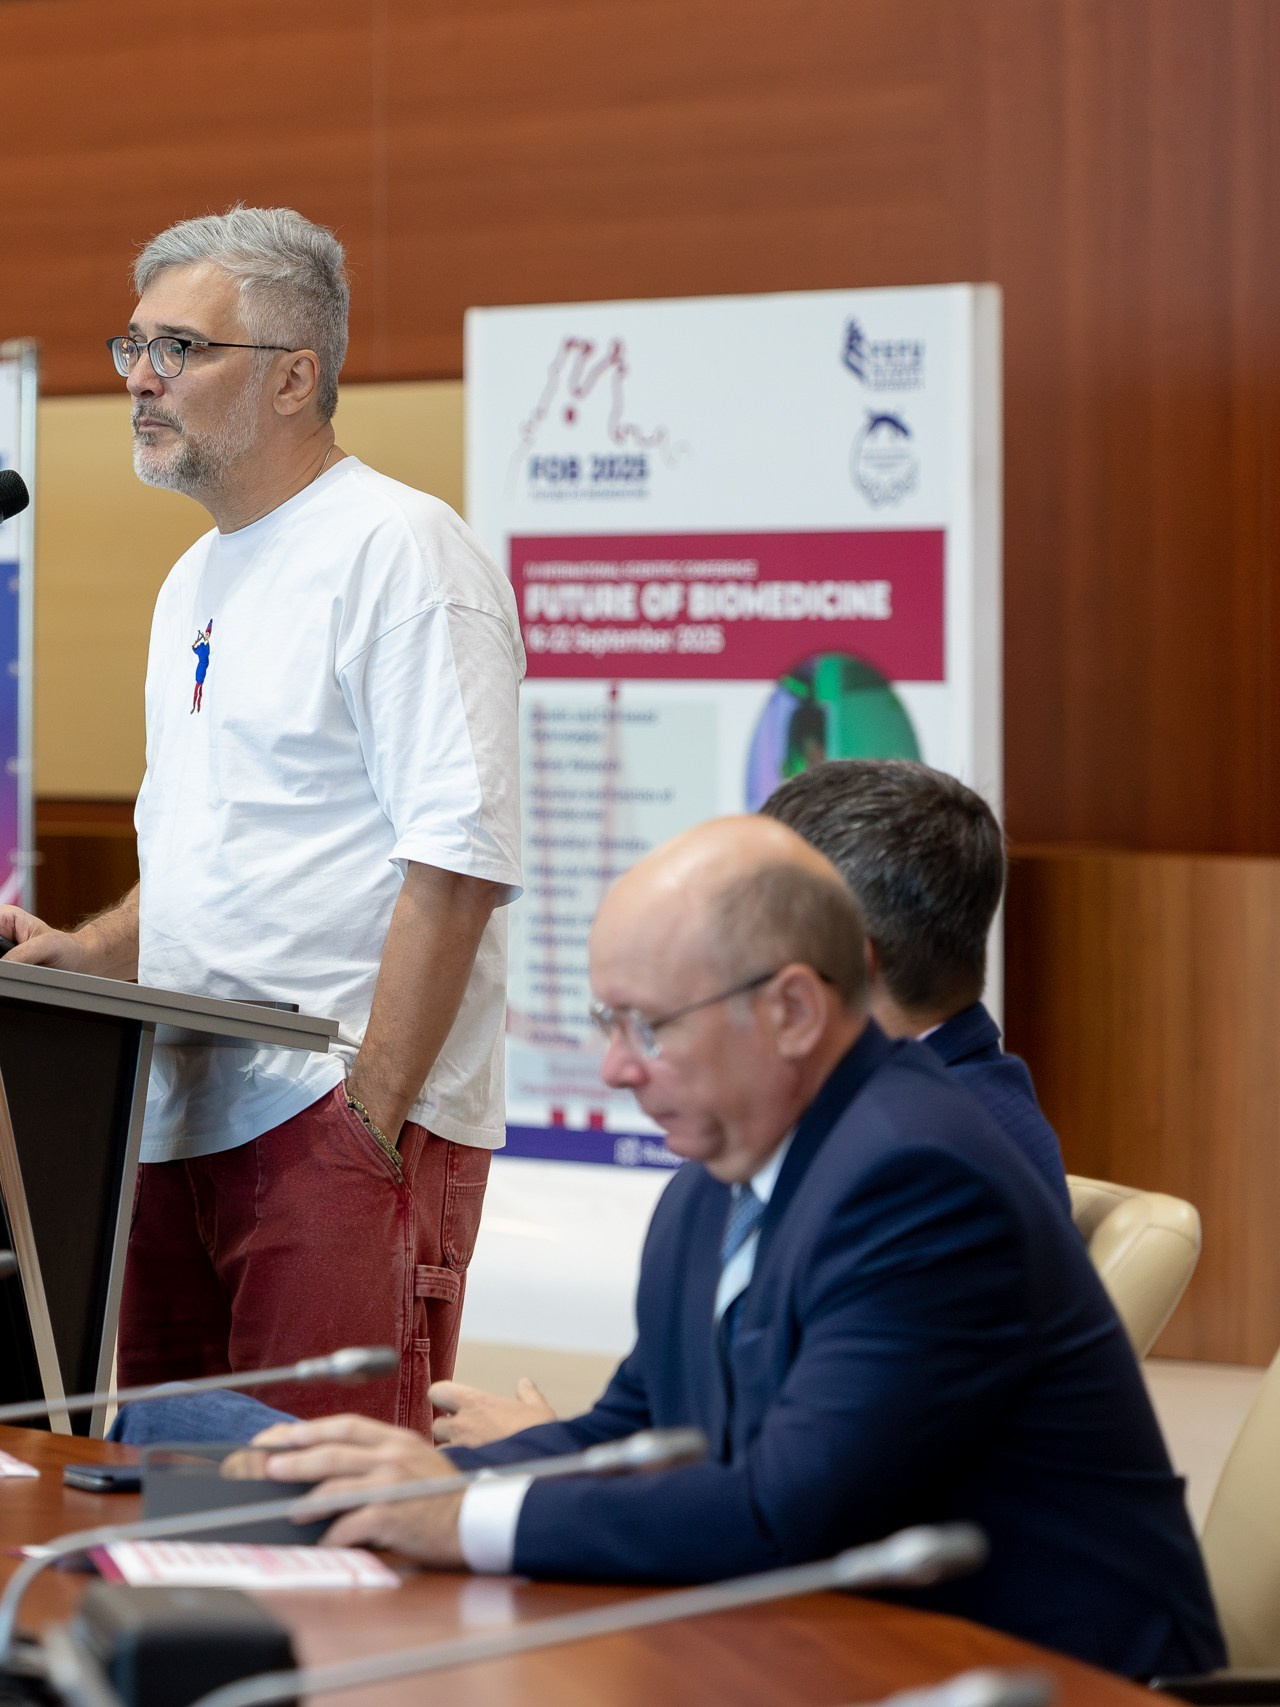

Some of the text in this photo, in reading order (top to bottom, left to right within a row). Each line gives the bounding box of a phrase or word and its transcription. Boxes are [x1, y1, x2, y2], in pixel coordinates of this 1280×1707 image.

[523, 580, 892, 621] FUTURE OF BIOMEDICINE
